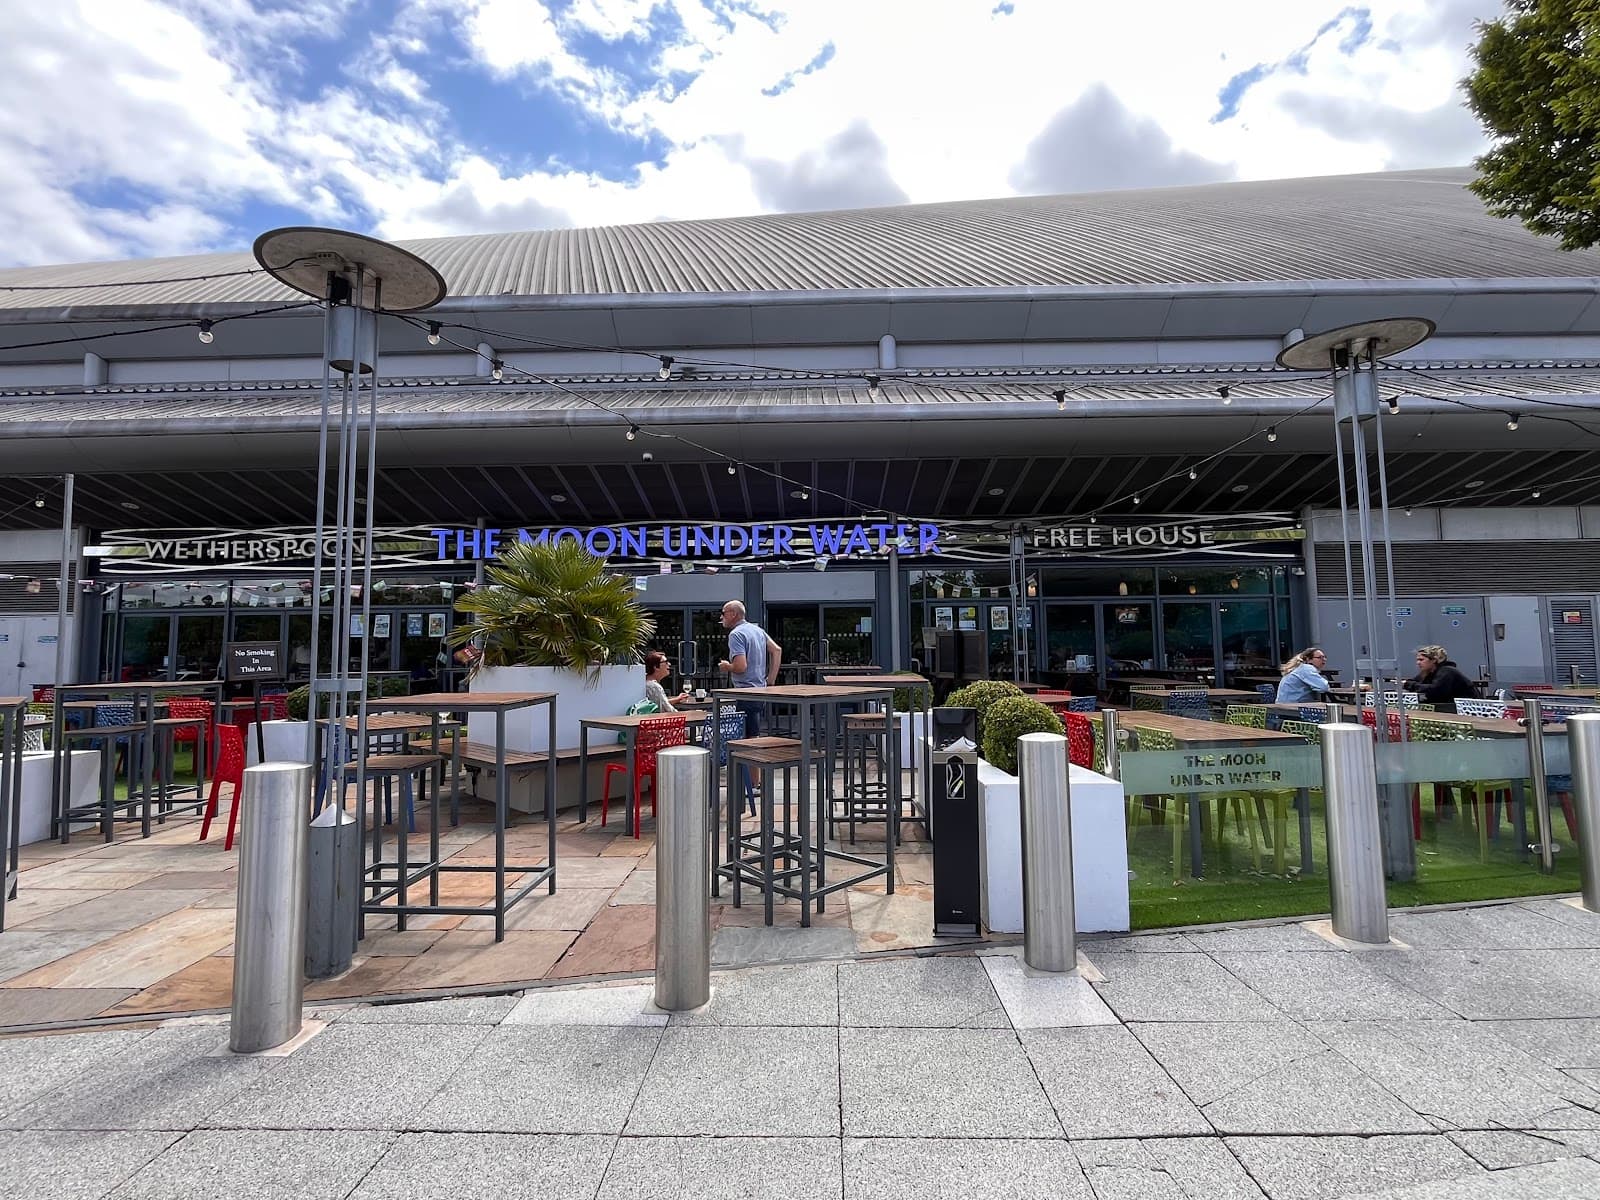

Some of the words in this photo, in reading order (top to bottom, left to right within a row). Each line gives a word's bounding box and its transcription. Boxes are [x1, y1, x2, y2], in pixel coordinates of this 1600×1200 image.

[430, 528, 501, 560] THE
[662, 524, 797, 556] UNDER
[808, 523, 942, 555] WATER
[1033, 527, 1102, 548] FREE
[1112, 525, 1215, 546] HOUSE
[144, 537, 368, 559] WETHERSPOON
[235, 649, 246, 657] No
[246, 649, 275, 657] Smoking
[1184, 755, 1215, 768] THE
[1220, 753, 1266, 766] MOON
[1170, 773, 1225, 787] UNDER
[1228, 771, 1281, 785] WATER
